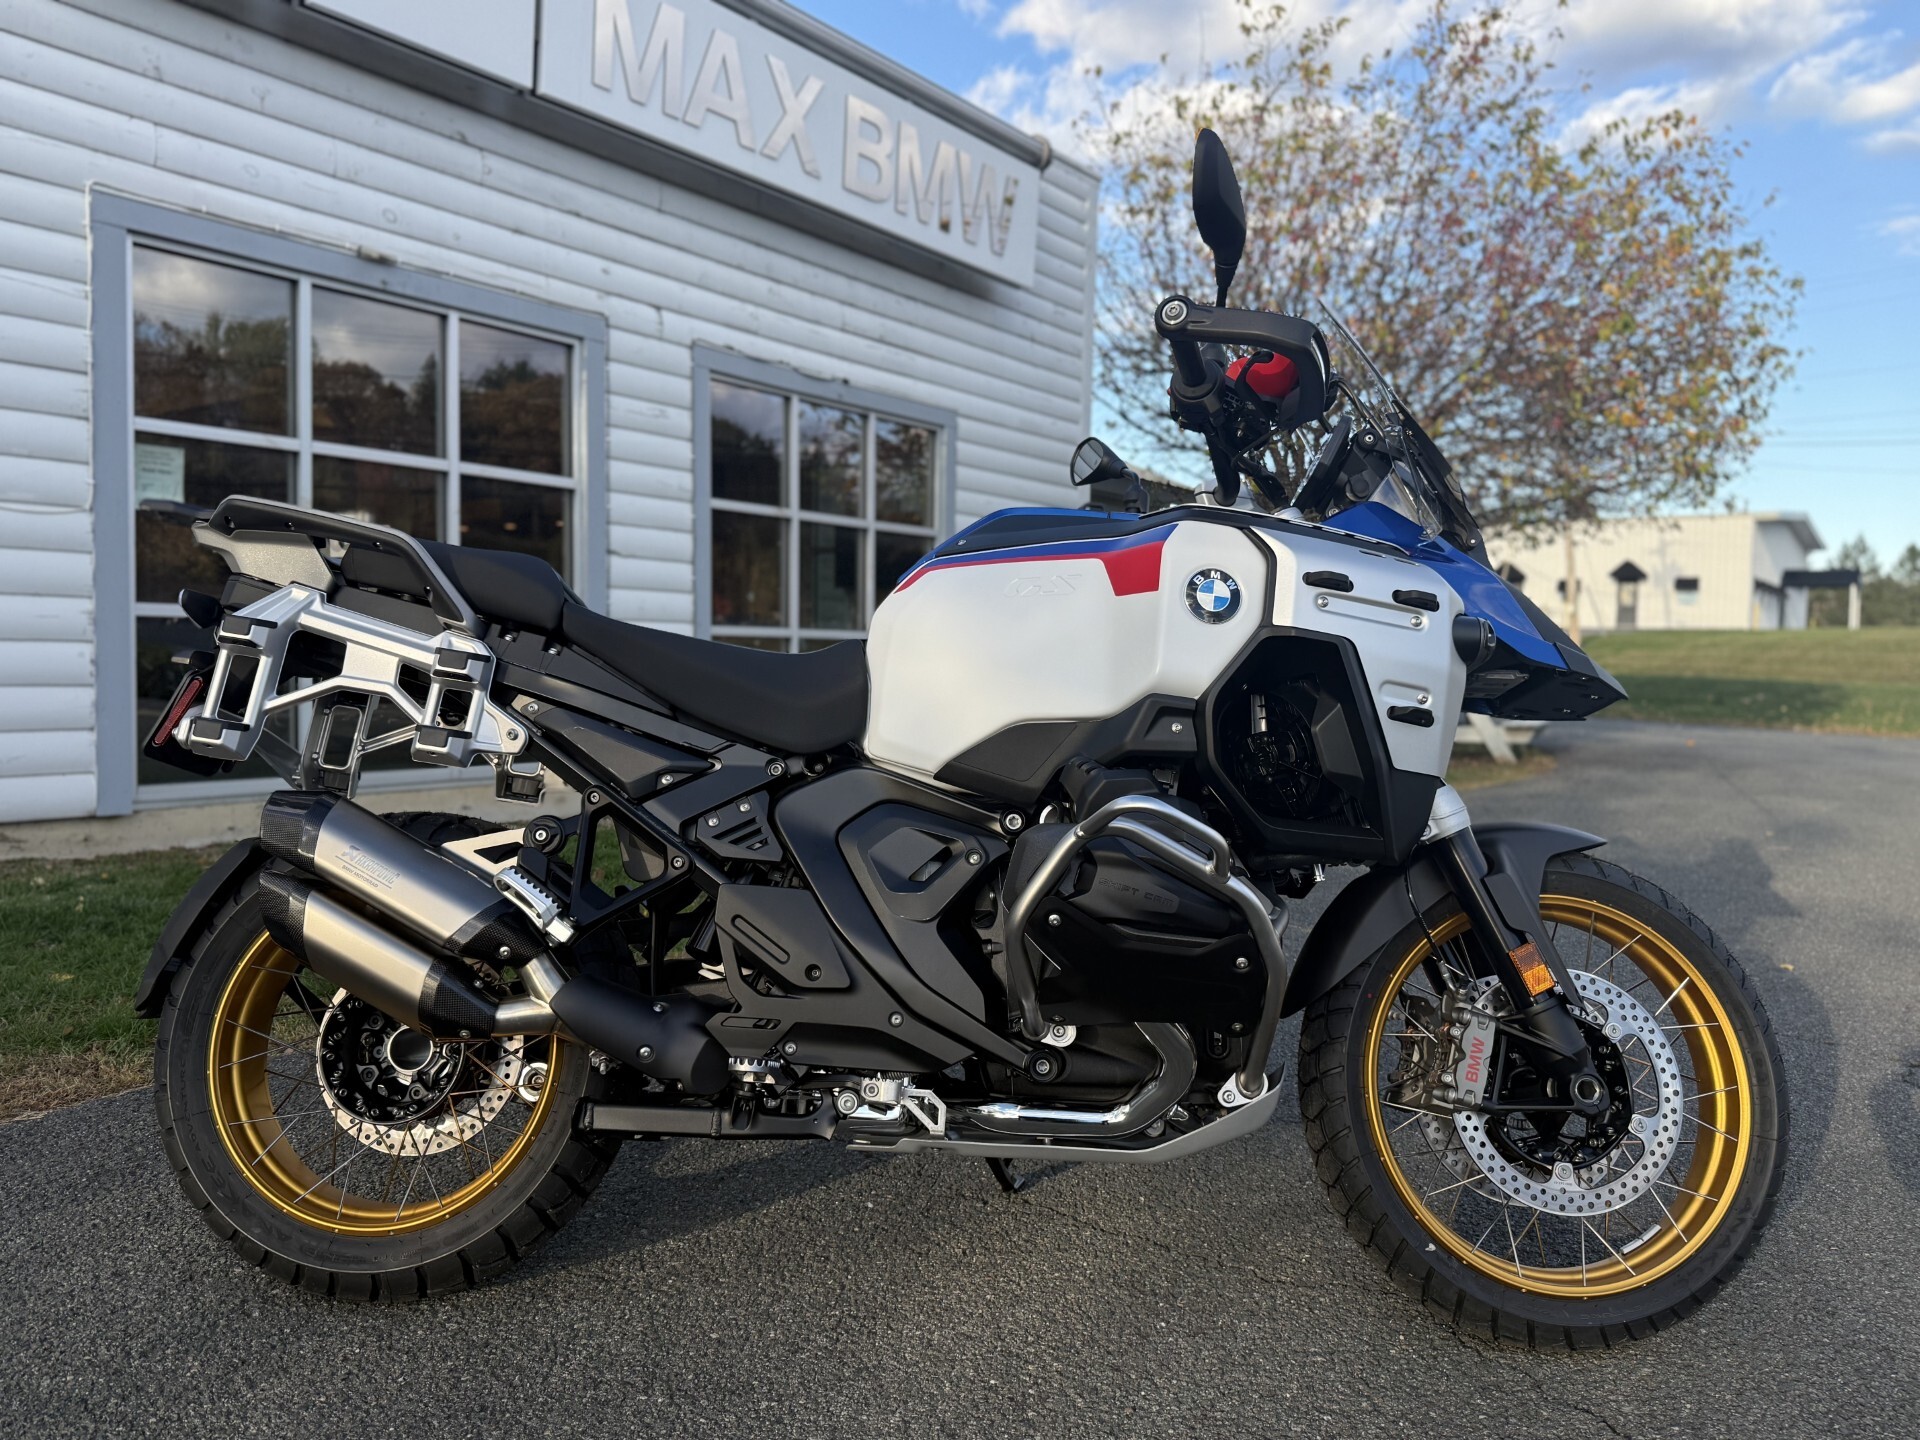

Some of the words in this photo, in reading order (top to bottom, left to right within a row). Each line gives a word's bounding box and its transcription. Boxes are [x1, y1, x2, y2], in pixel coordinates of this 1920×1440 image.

[591, 0, 822, 180] MAX
[842, 94, 1020, 257] BMW
[1192, 570, 1238, 590] BMW
[1466, 1037, 1485, 1083] BMW
